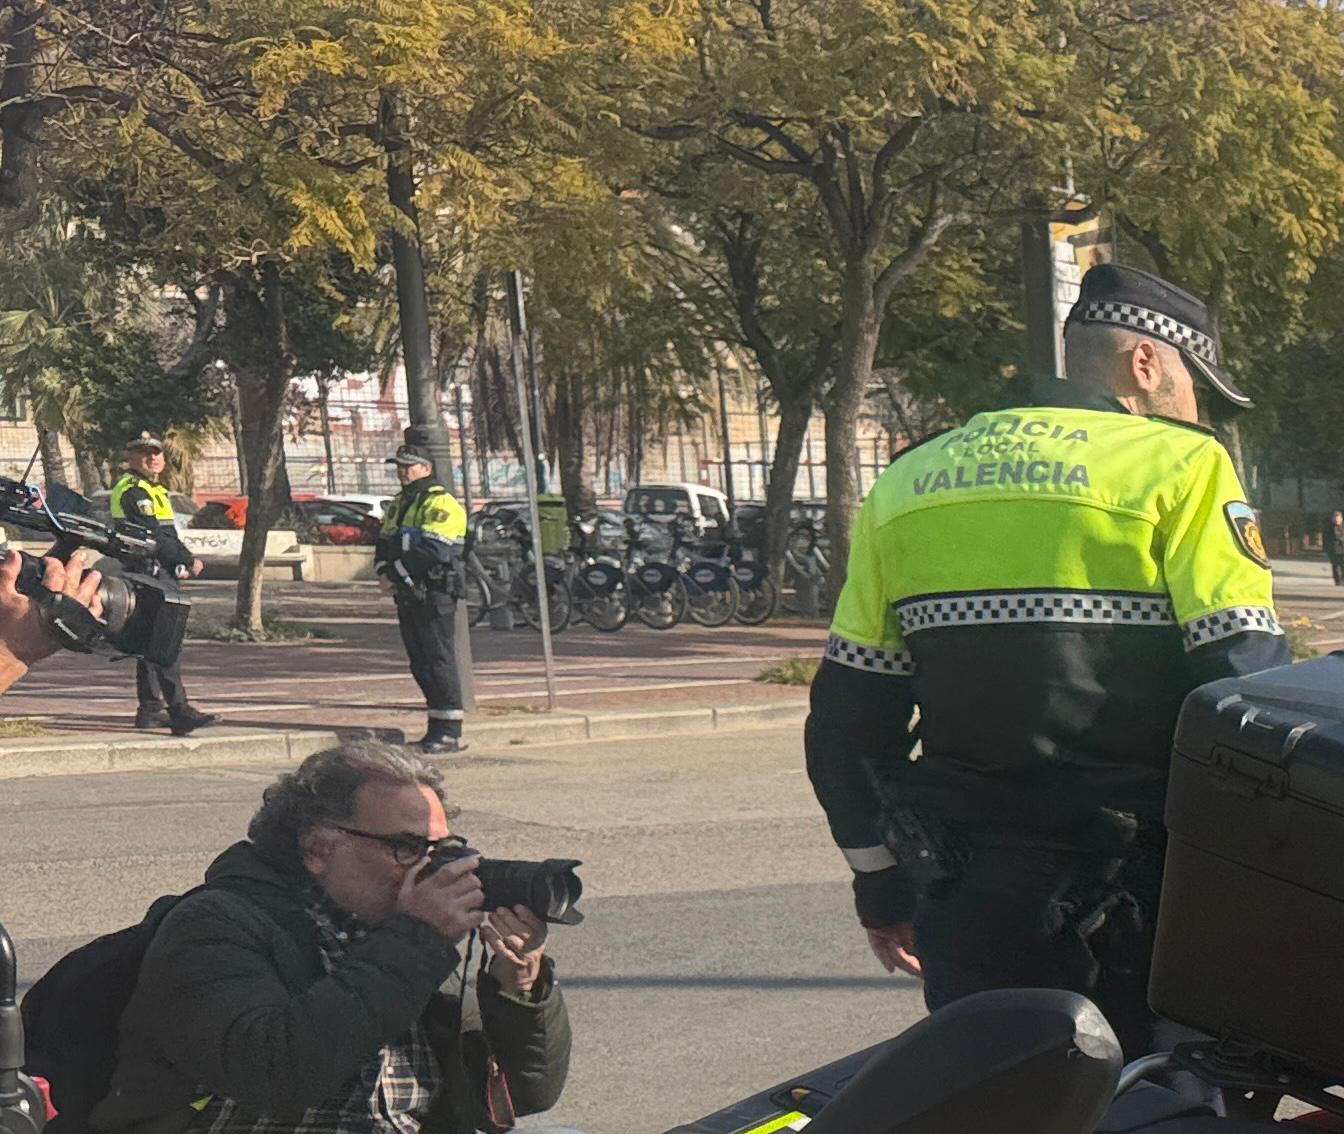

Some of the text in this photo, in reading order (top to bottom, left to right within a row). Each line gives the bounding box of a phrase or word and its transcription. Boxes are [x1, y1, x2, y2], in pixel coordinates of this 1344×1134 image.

[941, 416, 1089, 449] POLICIA
[964, 441, 1040, 458] LOCAL
[913, 460, 1090, 495] VALENCIA
